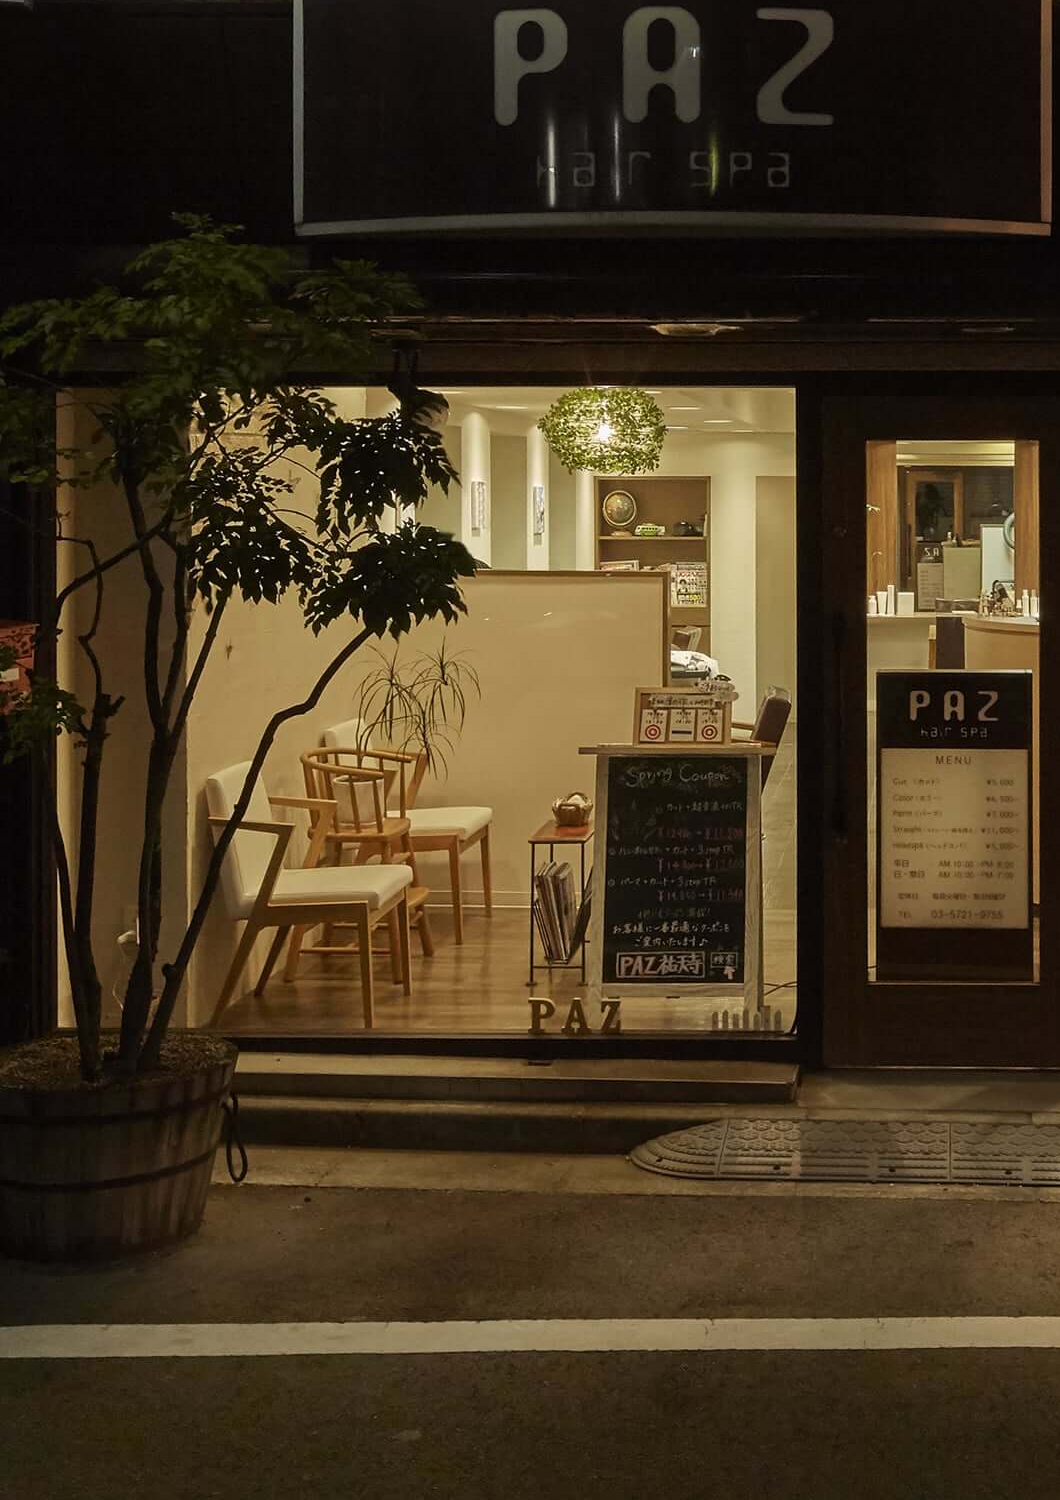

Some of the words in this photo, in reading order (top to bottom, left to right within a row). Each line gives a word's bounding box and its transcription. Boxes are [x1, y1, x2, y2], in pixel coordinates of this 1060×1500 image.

[493, 6, 835, 127] PAZ
[909, 690, 999, 722] PAZ
[625, 765, 673, 788] Spring
[679, 763, 730, 786] Coupon
[935, 755, 972, 765] MENU
[528, 996, 622, 1035] PAZ
